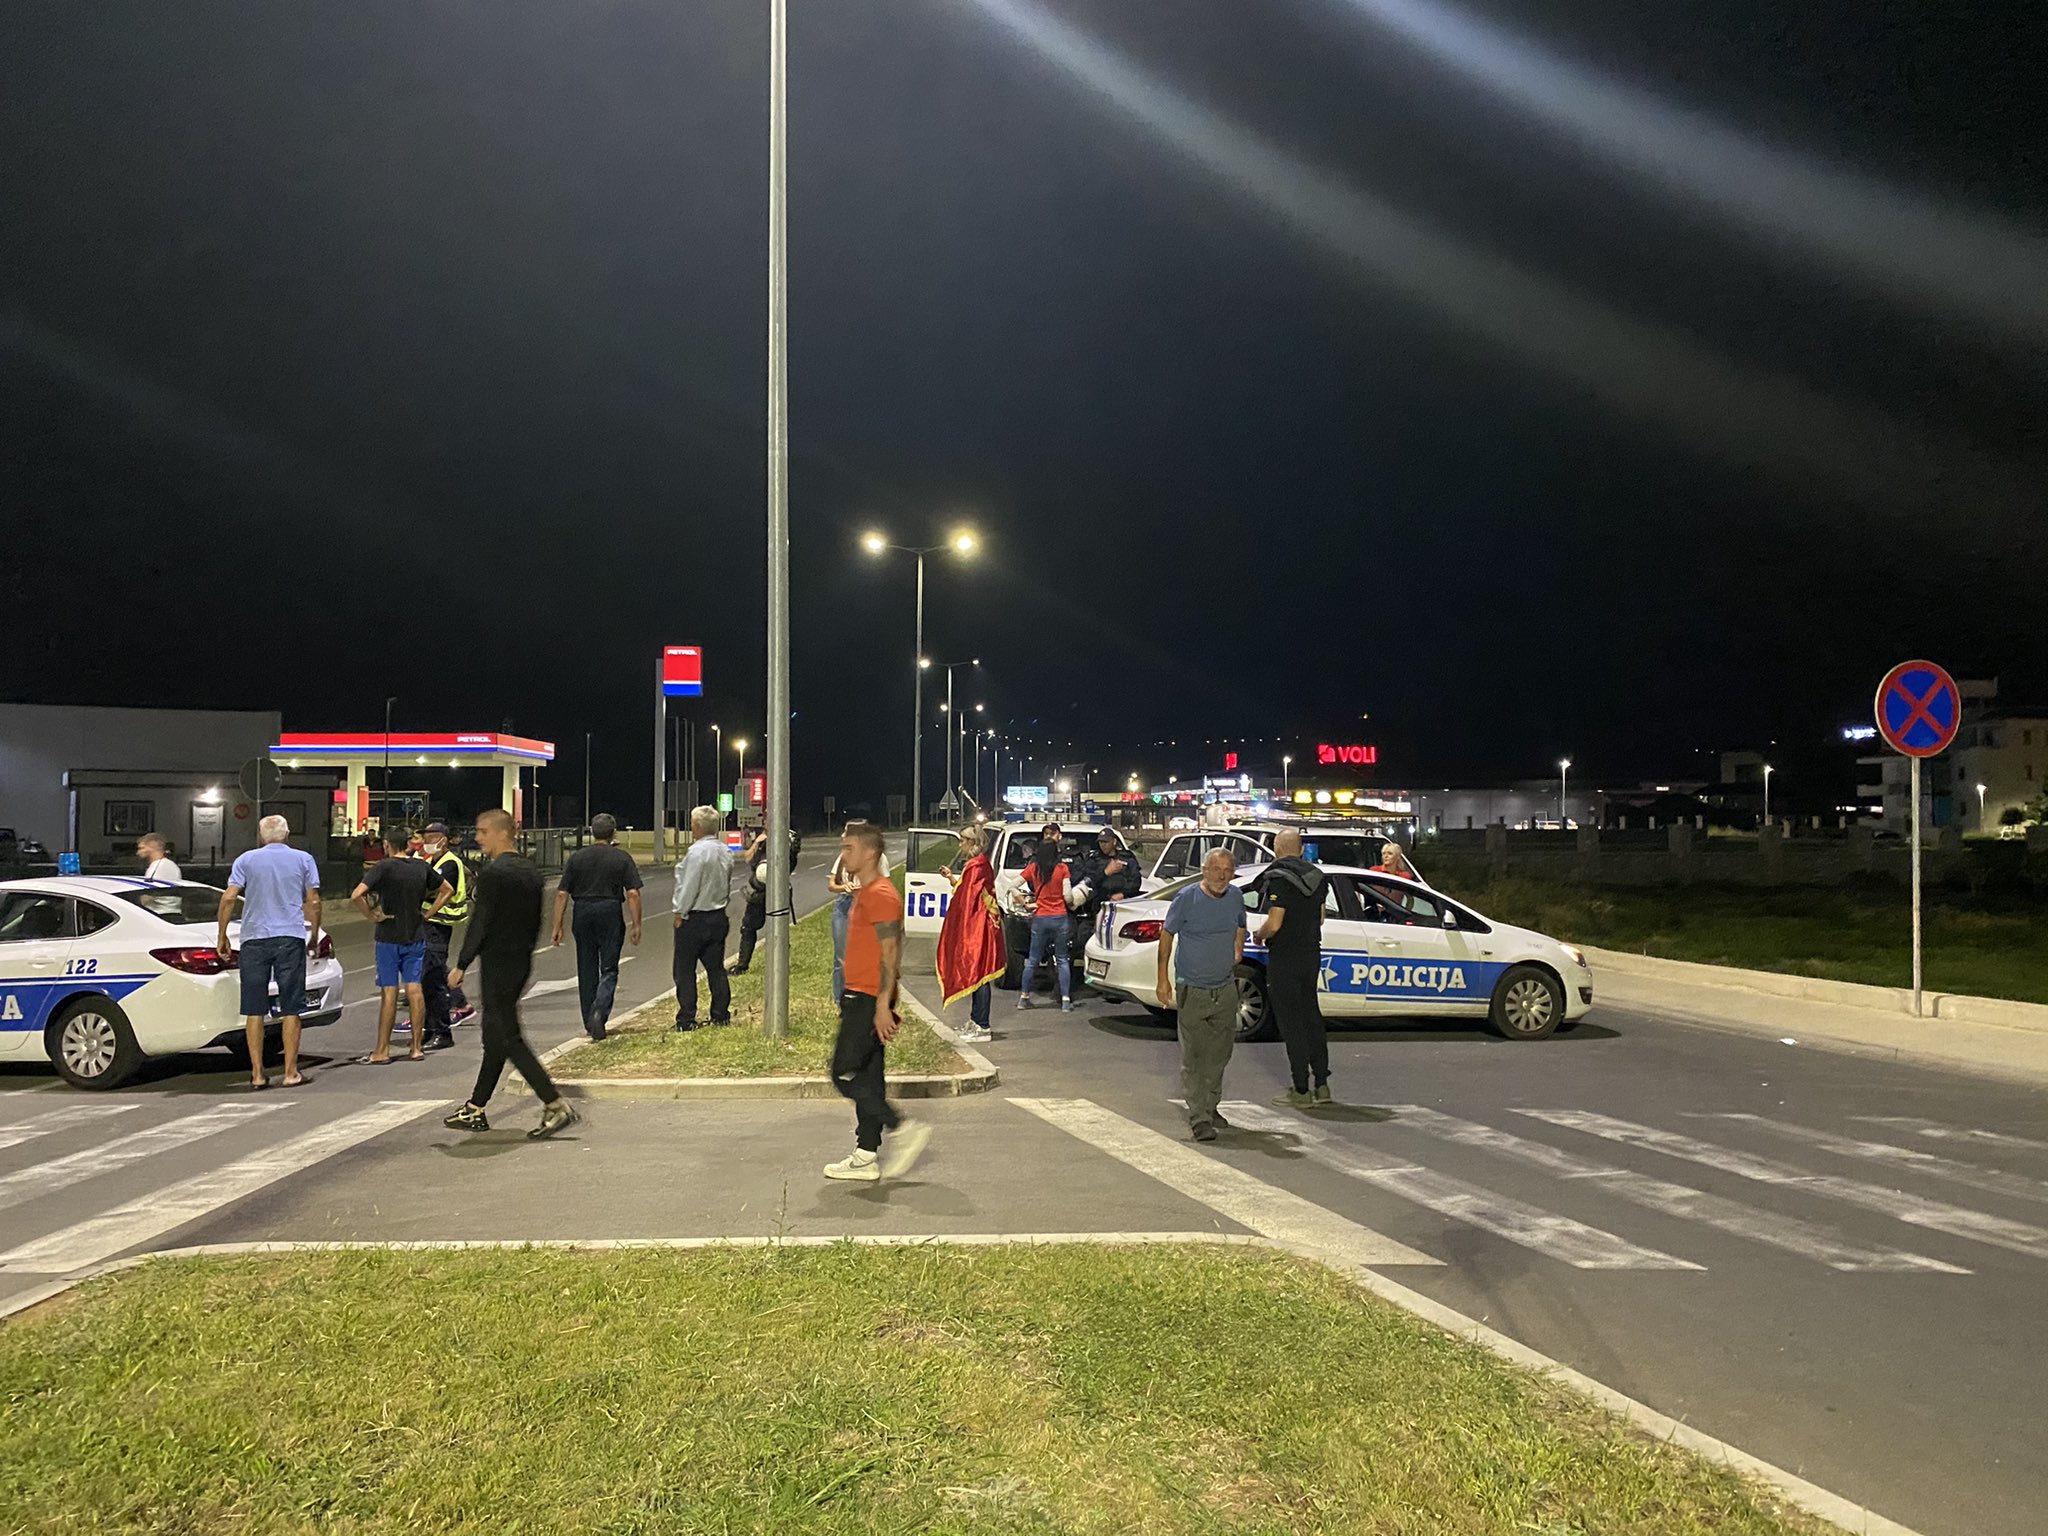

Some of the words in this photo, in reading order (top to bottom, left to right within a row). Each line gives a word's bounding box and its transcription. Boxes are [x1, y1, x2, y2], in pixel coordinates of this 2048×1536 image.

[1338, 746, 1376, 763] VOLI
[66, 959, 98, 975] 122
[1350, 963, 1467, 993] POLICIJA
